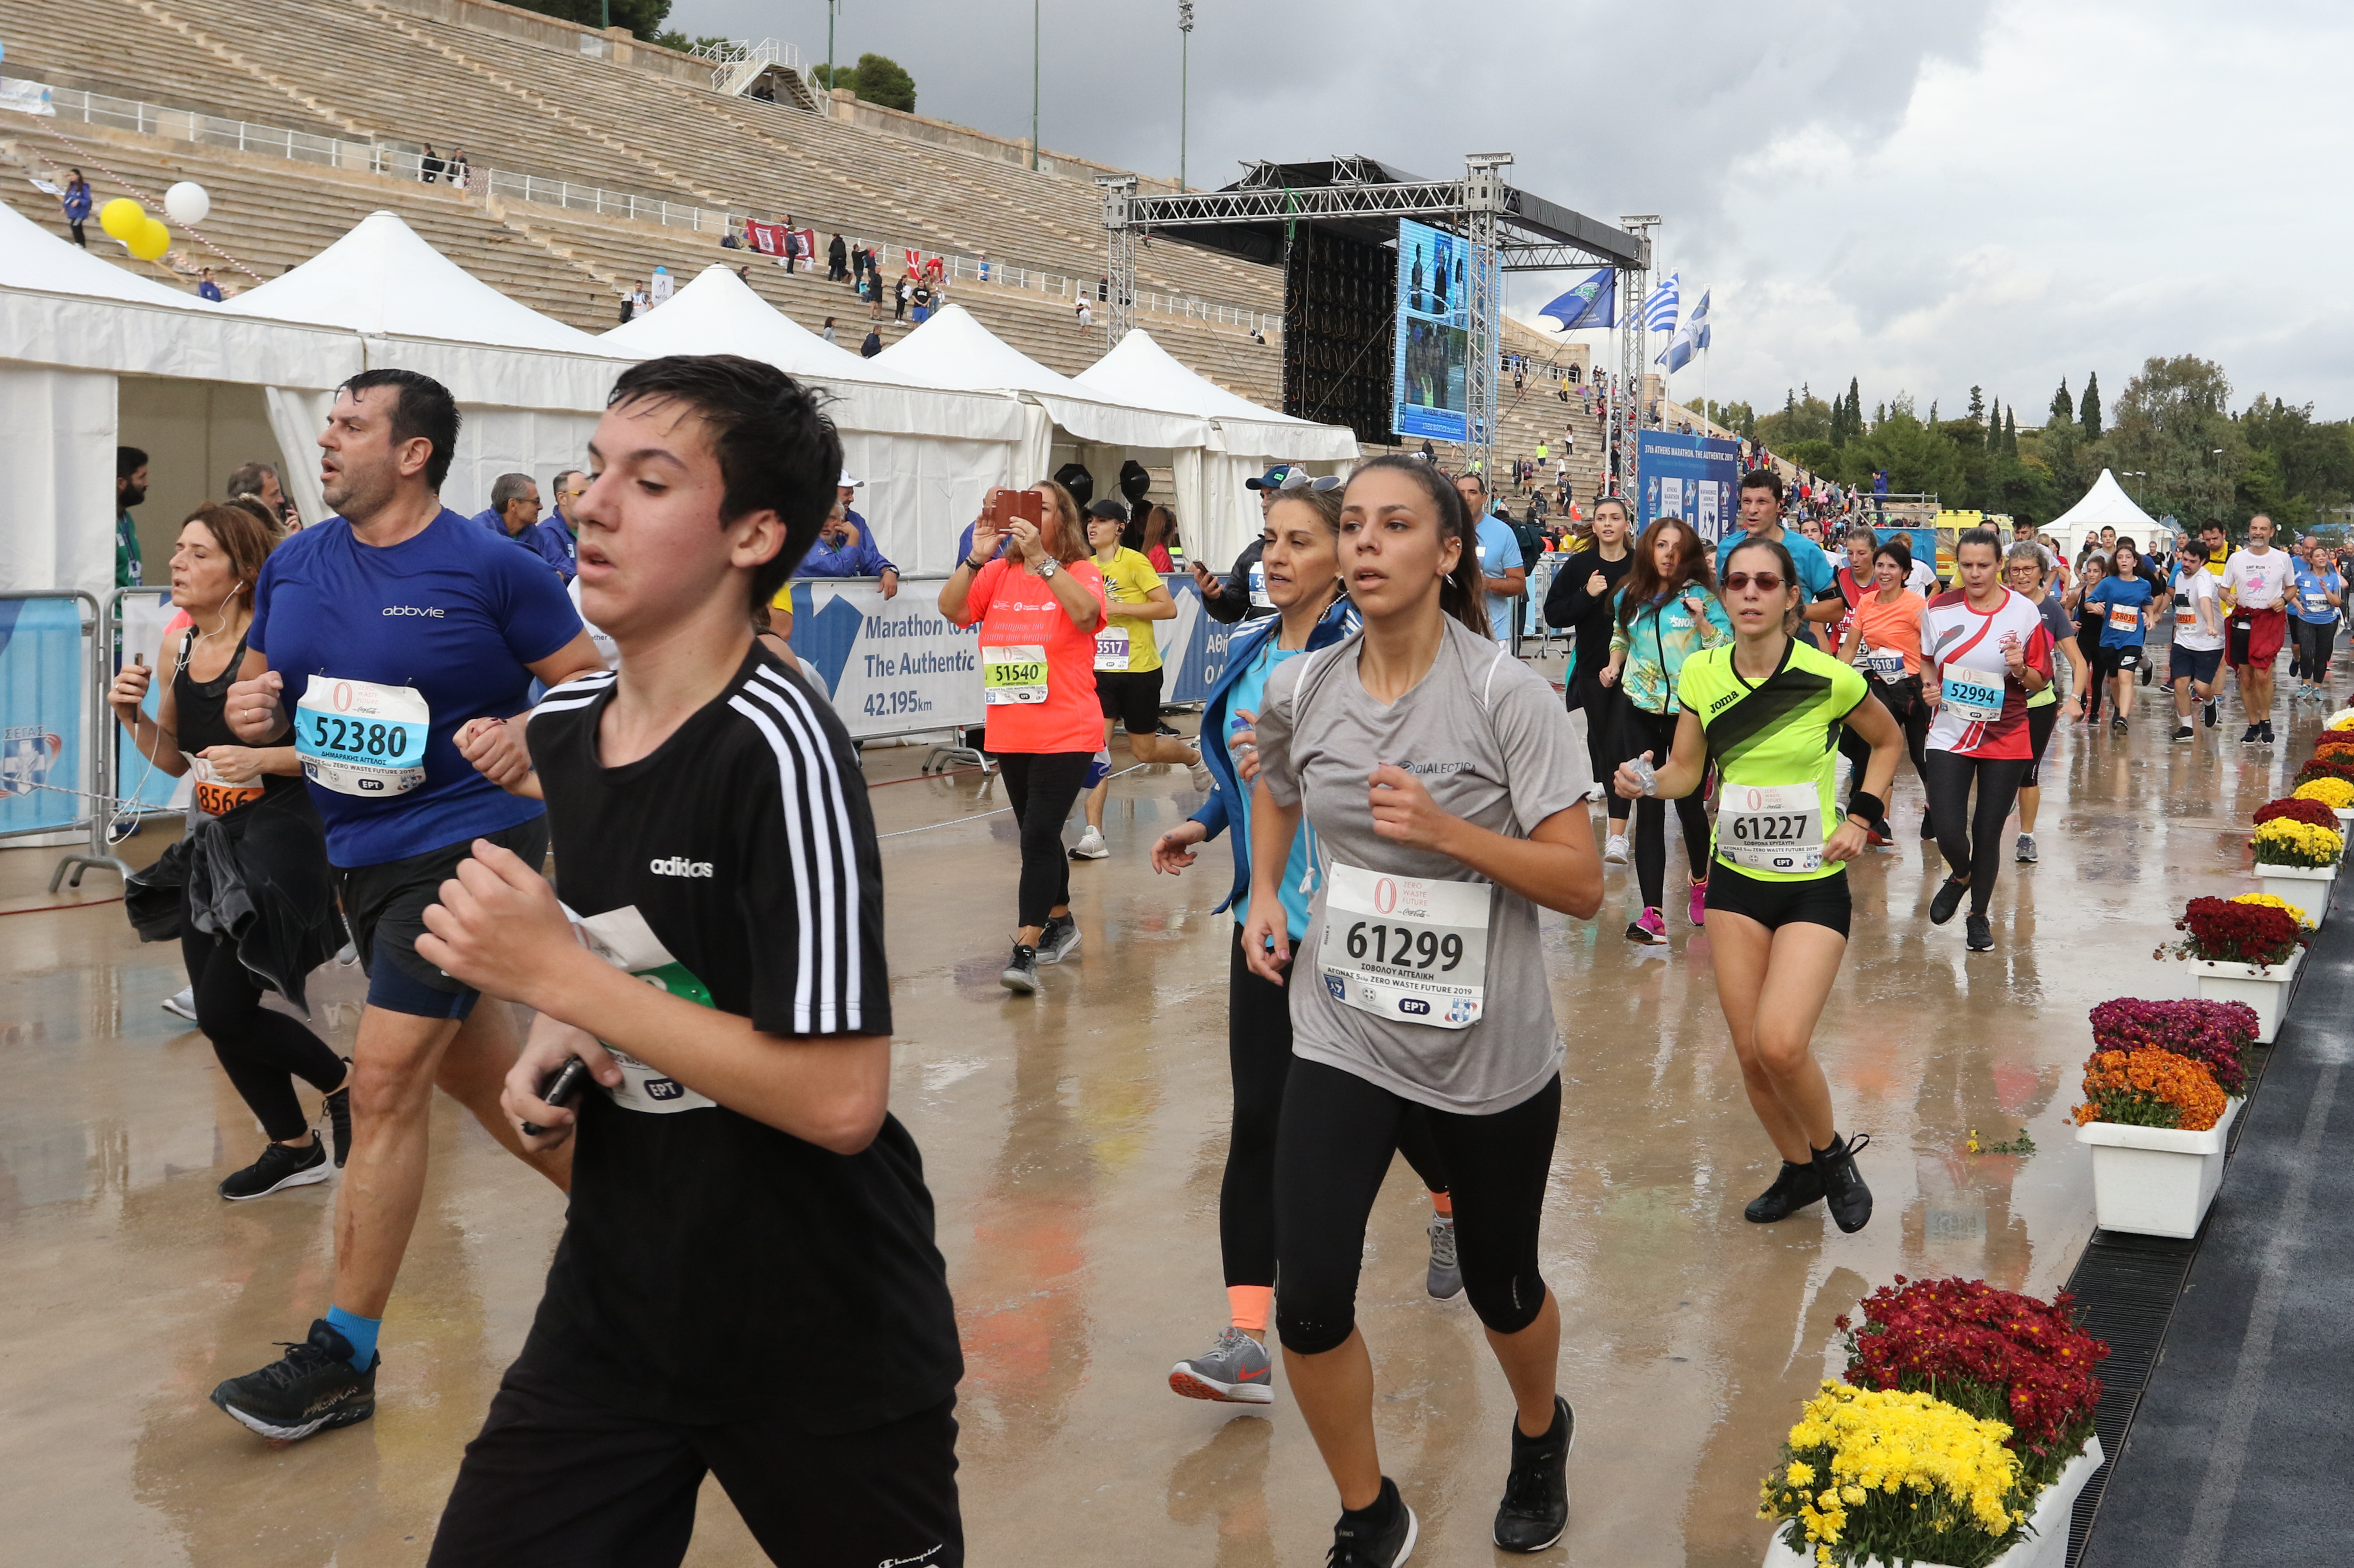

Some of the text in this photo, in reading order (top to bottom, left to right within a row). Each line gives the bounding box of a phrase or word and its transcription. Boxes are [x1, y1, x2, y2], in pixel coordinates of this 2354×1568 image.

[1645, 444, 1653, 453] 37th
[1655, 446, 1670, 455] ATHENS
[1703, 451, 1724, 460] AUTHENTIC
[1725, 453, 1734, 461] 2019
[382, 605, 444, 618] abbvie
[2115, 612, 2135, 622] 58036
[865, 613, 943, 639] Marathon
[1097, 641, 1123, 653] 5517
[865, 649, 974, 678] The Authentic
[1872, 659, 1896, 670] 56187
[996, 664, 1039, 681] 51540
[1951, 683, 1995, 704] 52994
[5, 725, 44, 739] ΣΕΓΑΣ
[314, 716, 406, 757] 52380
[321, 751, 387, 766] ΔΗΜΑΡΑΚΗΣ ΑΓΓΕΛΟΣ
[1734, 815, 1807, 840] 61227
[650, 857, 713, 878] adidas
[1402, 898, 1428, 906] FUTURE
[1403, 889, 1427, 898] WASTE
[1347, 921, 1463, 972] 61299
[1361, 962, 1434, 981] ΣΟΒΟΛΟΥ ΑΓΓΕΛΙΚΗ
[1328, 967, 1355, 979] ΑΓΩΝΑΣ
[1370, 976, 1391, 985] ZERO
[1392, 980, 1419, 990] WASTE
[1420, 984, 1452, 994] FUTURE
